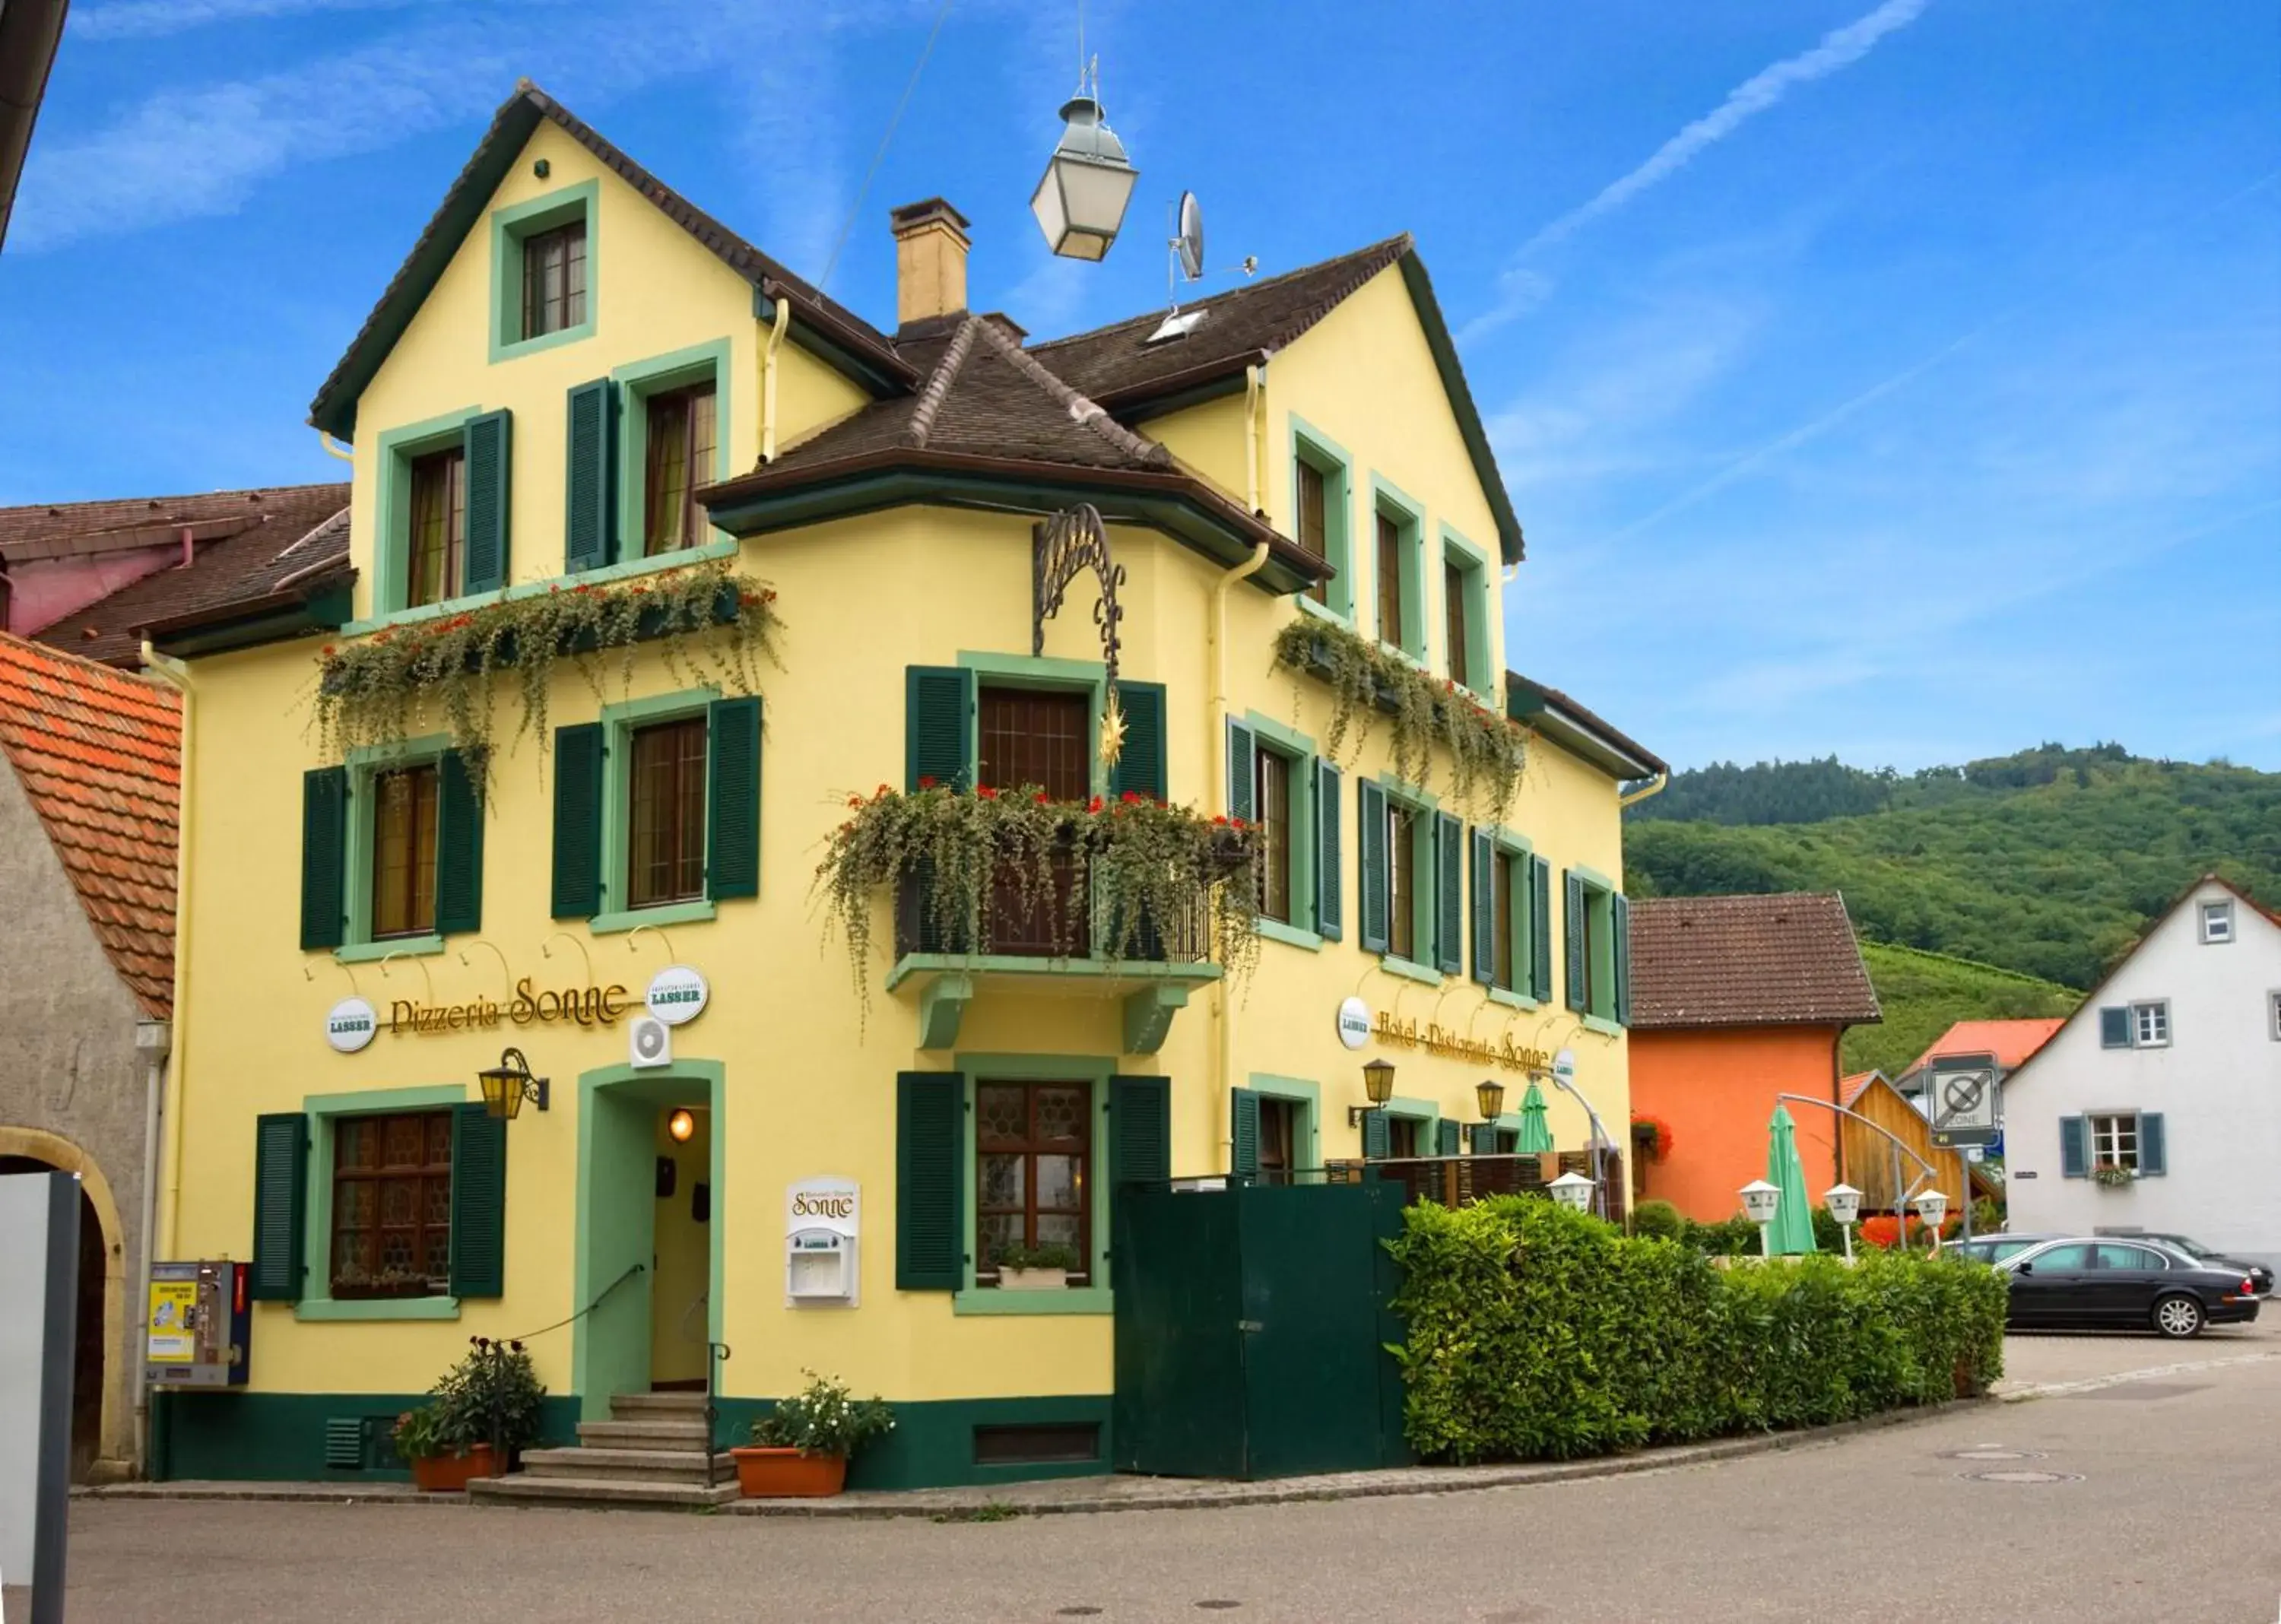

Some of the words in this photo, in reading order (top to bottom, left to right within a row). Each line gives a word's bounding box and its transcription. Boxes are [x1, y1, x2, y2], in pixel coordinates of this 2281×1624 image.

[391, 994, 499, 1033] Pizzeria
[509, 976, 628, 1026] Sonne
[652, 990, 701, 1005] LASSER
[331, 1020, 370, 1033] LASSER
[1379, 1010, 1417, 1048] Hotel
[1502, 1032, 1549, 1074] Sonne
[792, 1192, 853, 1219] Sonne
